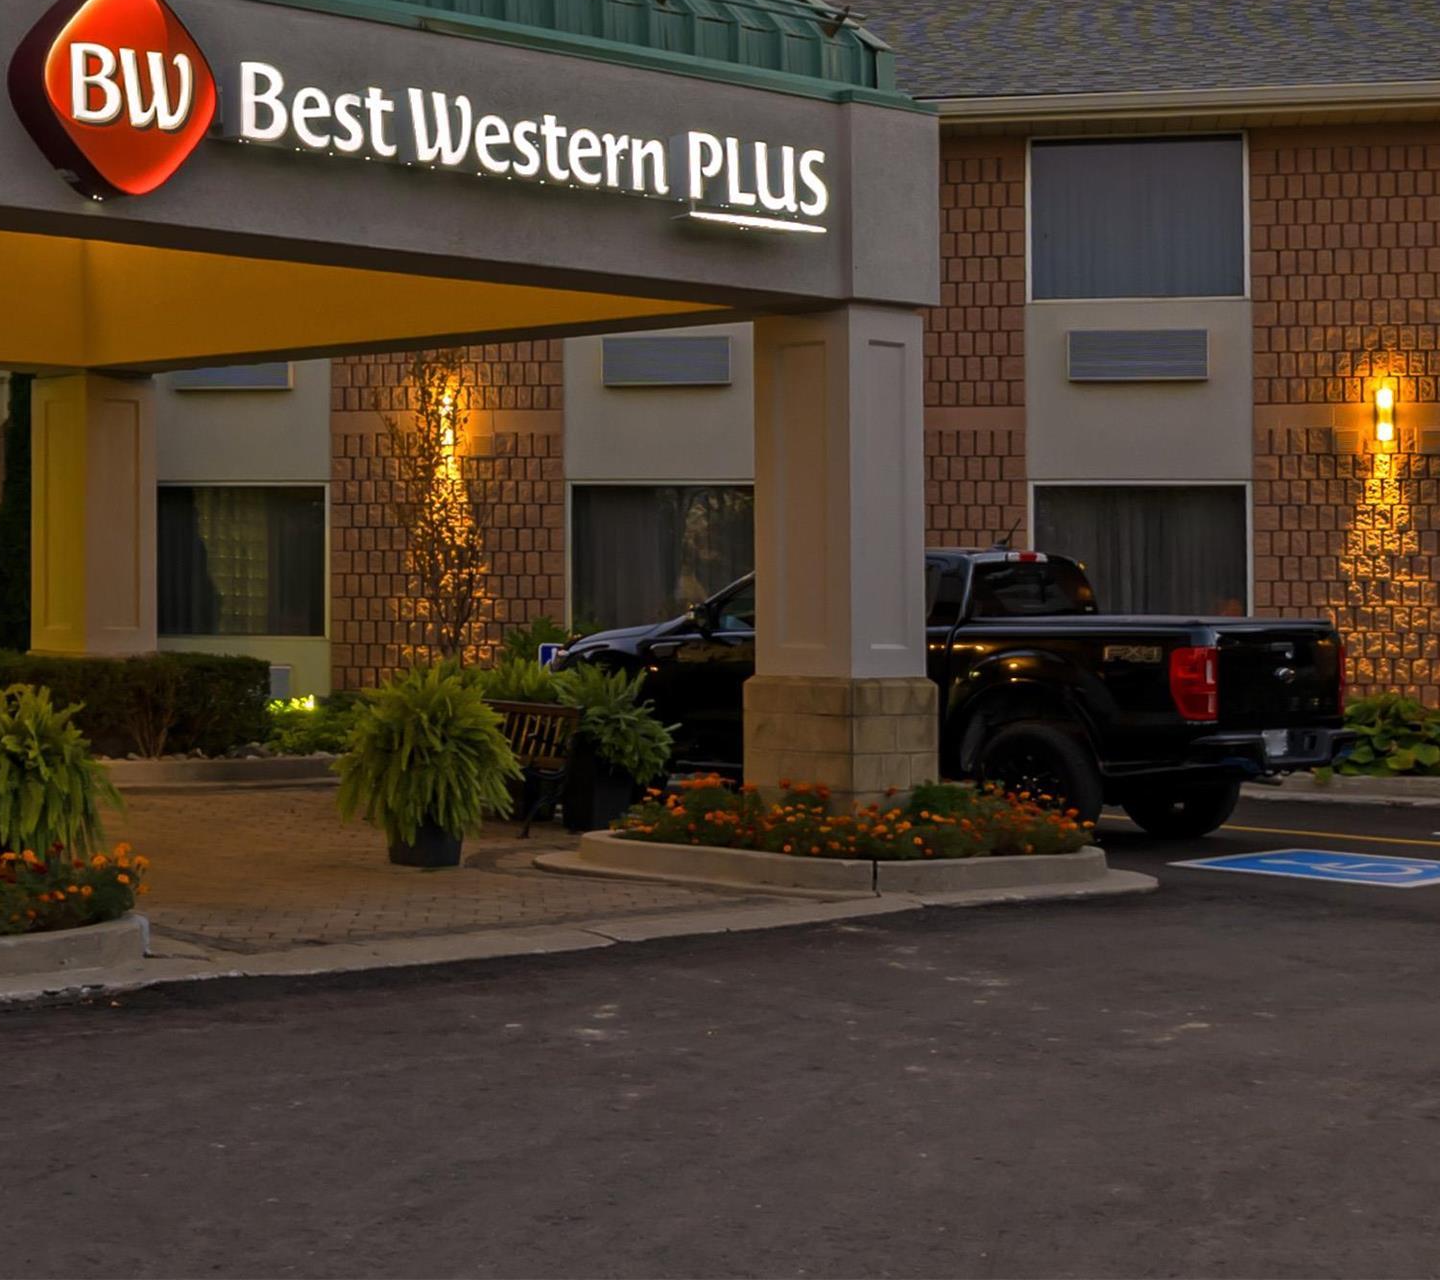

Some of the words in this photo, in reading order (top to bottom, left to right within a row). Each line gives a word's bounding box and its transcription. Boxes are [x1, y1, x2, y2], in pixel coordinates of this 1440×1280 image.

[69, 43, 194, 131] BW
[240, 61, 398, 157] Best
[408, 88, 670, 195] Western
[689, 131, 828, 217] PLUS
